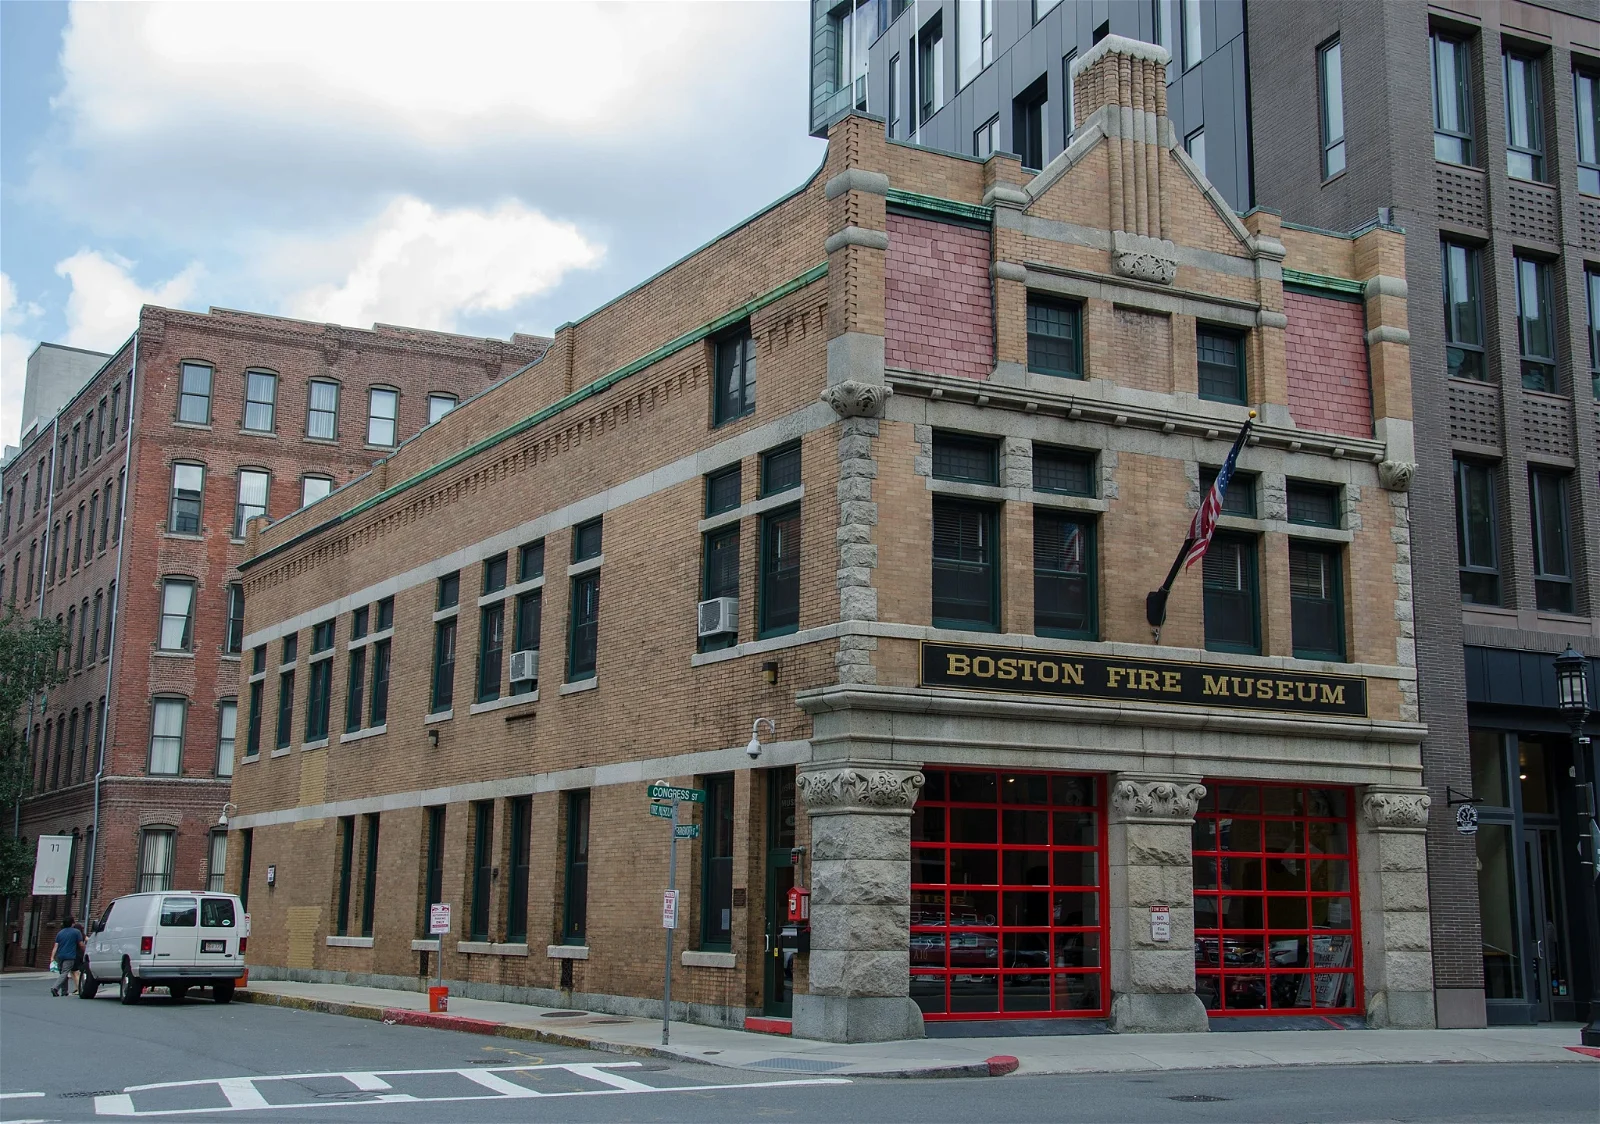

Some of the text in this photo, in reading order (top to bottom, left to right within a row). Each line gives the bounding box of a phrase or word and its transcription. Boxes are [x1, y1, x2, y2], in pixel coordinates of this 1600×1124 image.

[946, 653, 1346, 705] BOSTON FIRE MUSEUM
[652, 787, 699, 801] CONGRESS ST
[50, 843, 60, 853] 77
